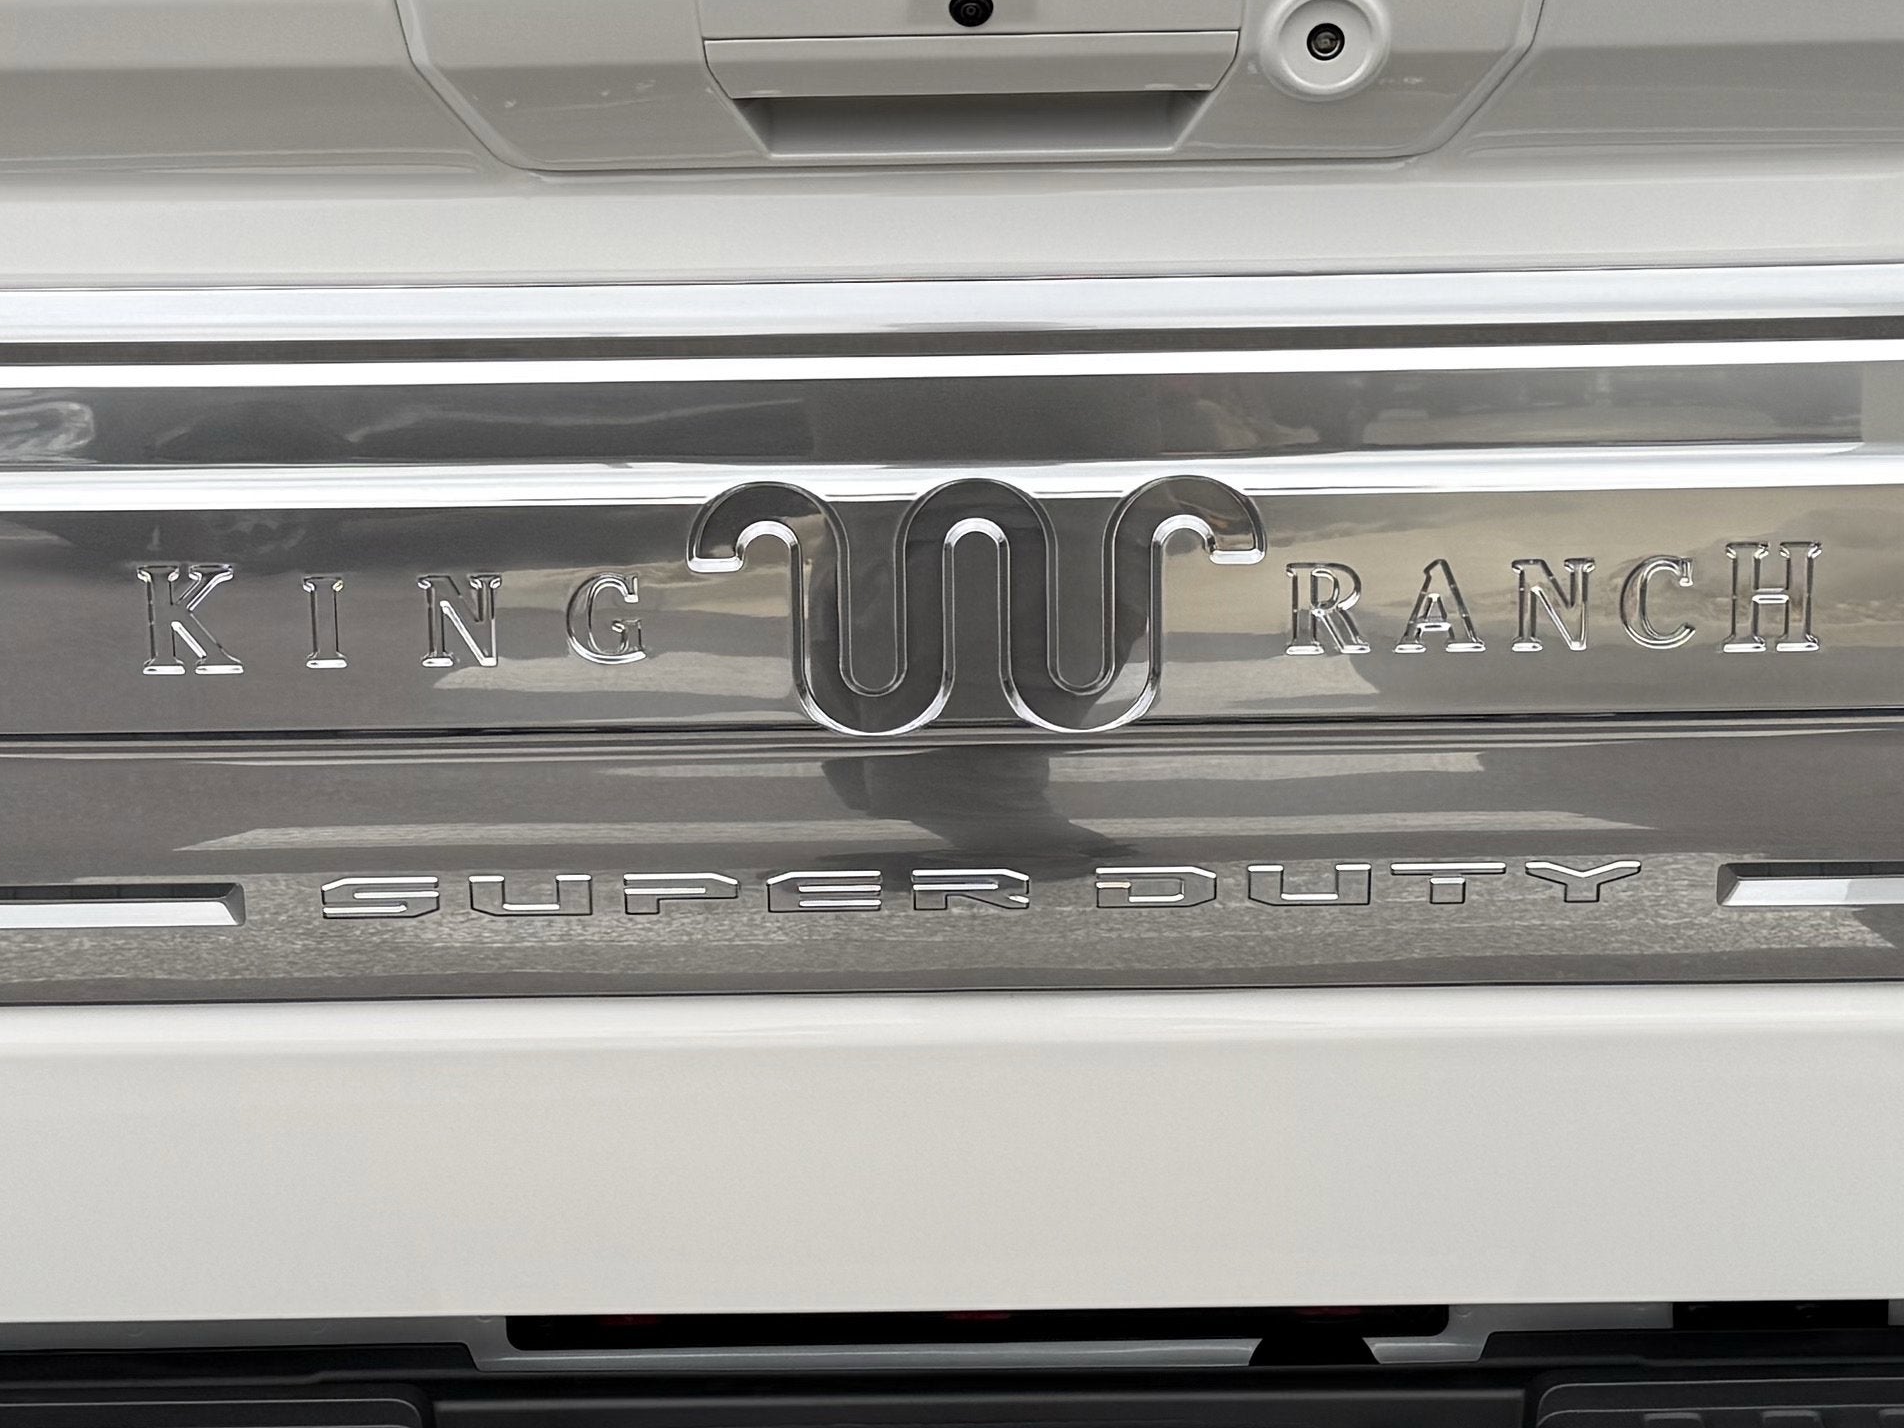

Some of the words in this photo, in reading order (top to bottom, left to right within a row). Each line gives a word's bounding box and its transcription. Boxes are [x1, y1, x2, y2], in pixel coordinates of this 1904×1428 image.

[137, 563, 646, 675] KING
[1286, 540, 1822, 655] RANCH
[322, 869, 1029, 918] SUPER
[1096, 861, 1641, 908] DUTY
